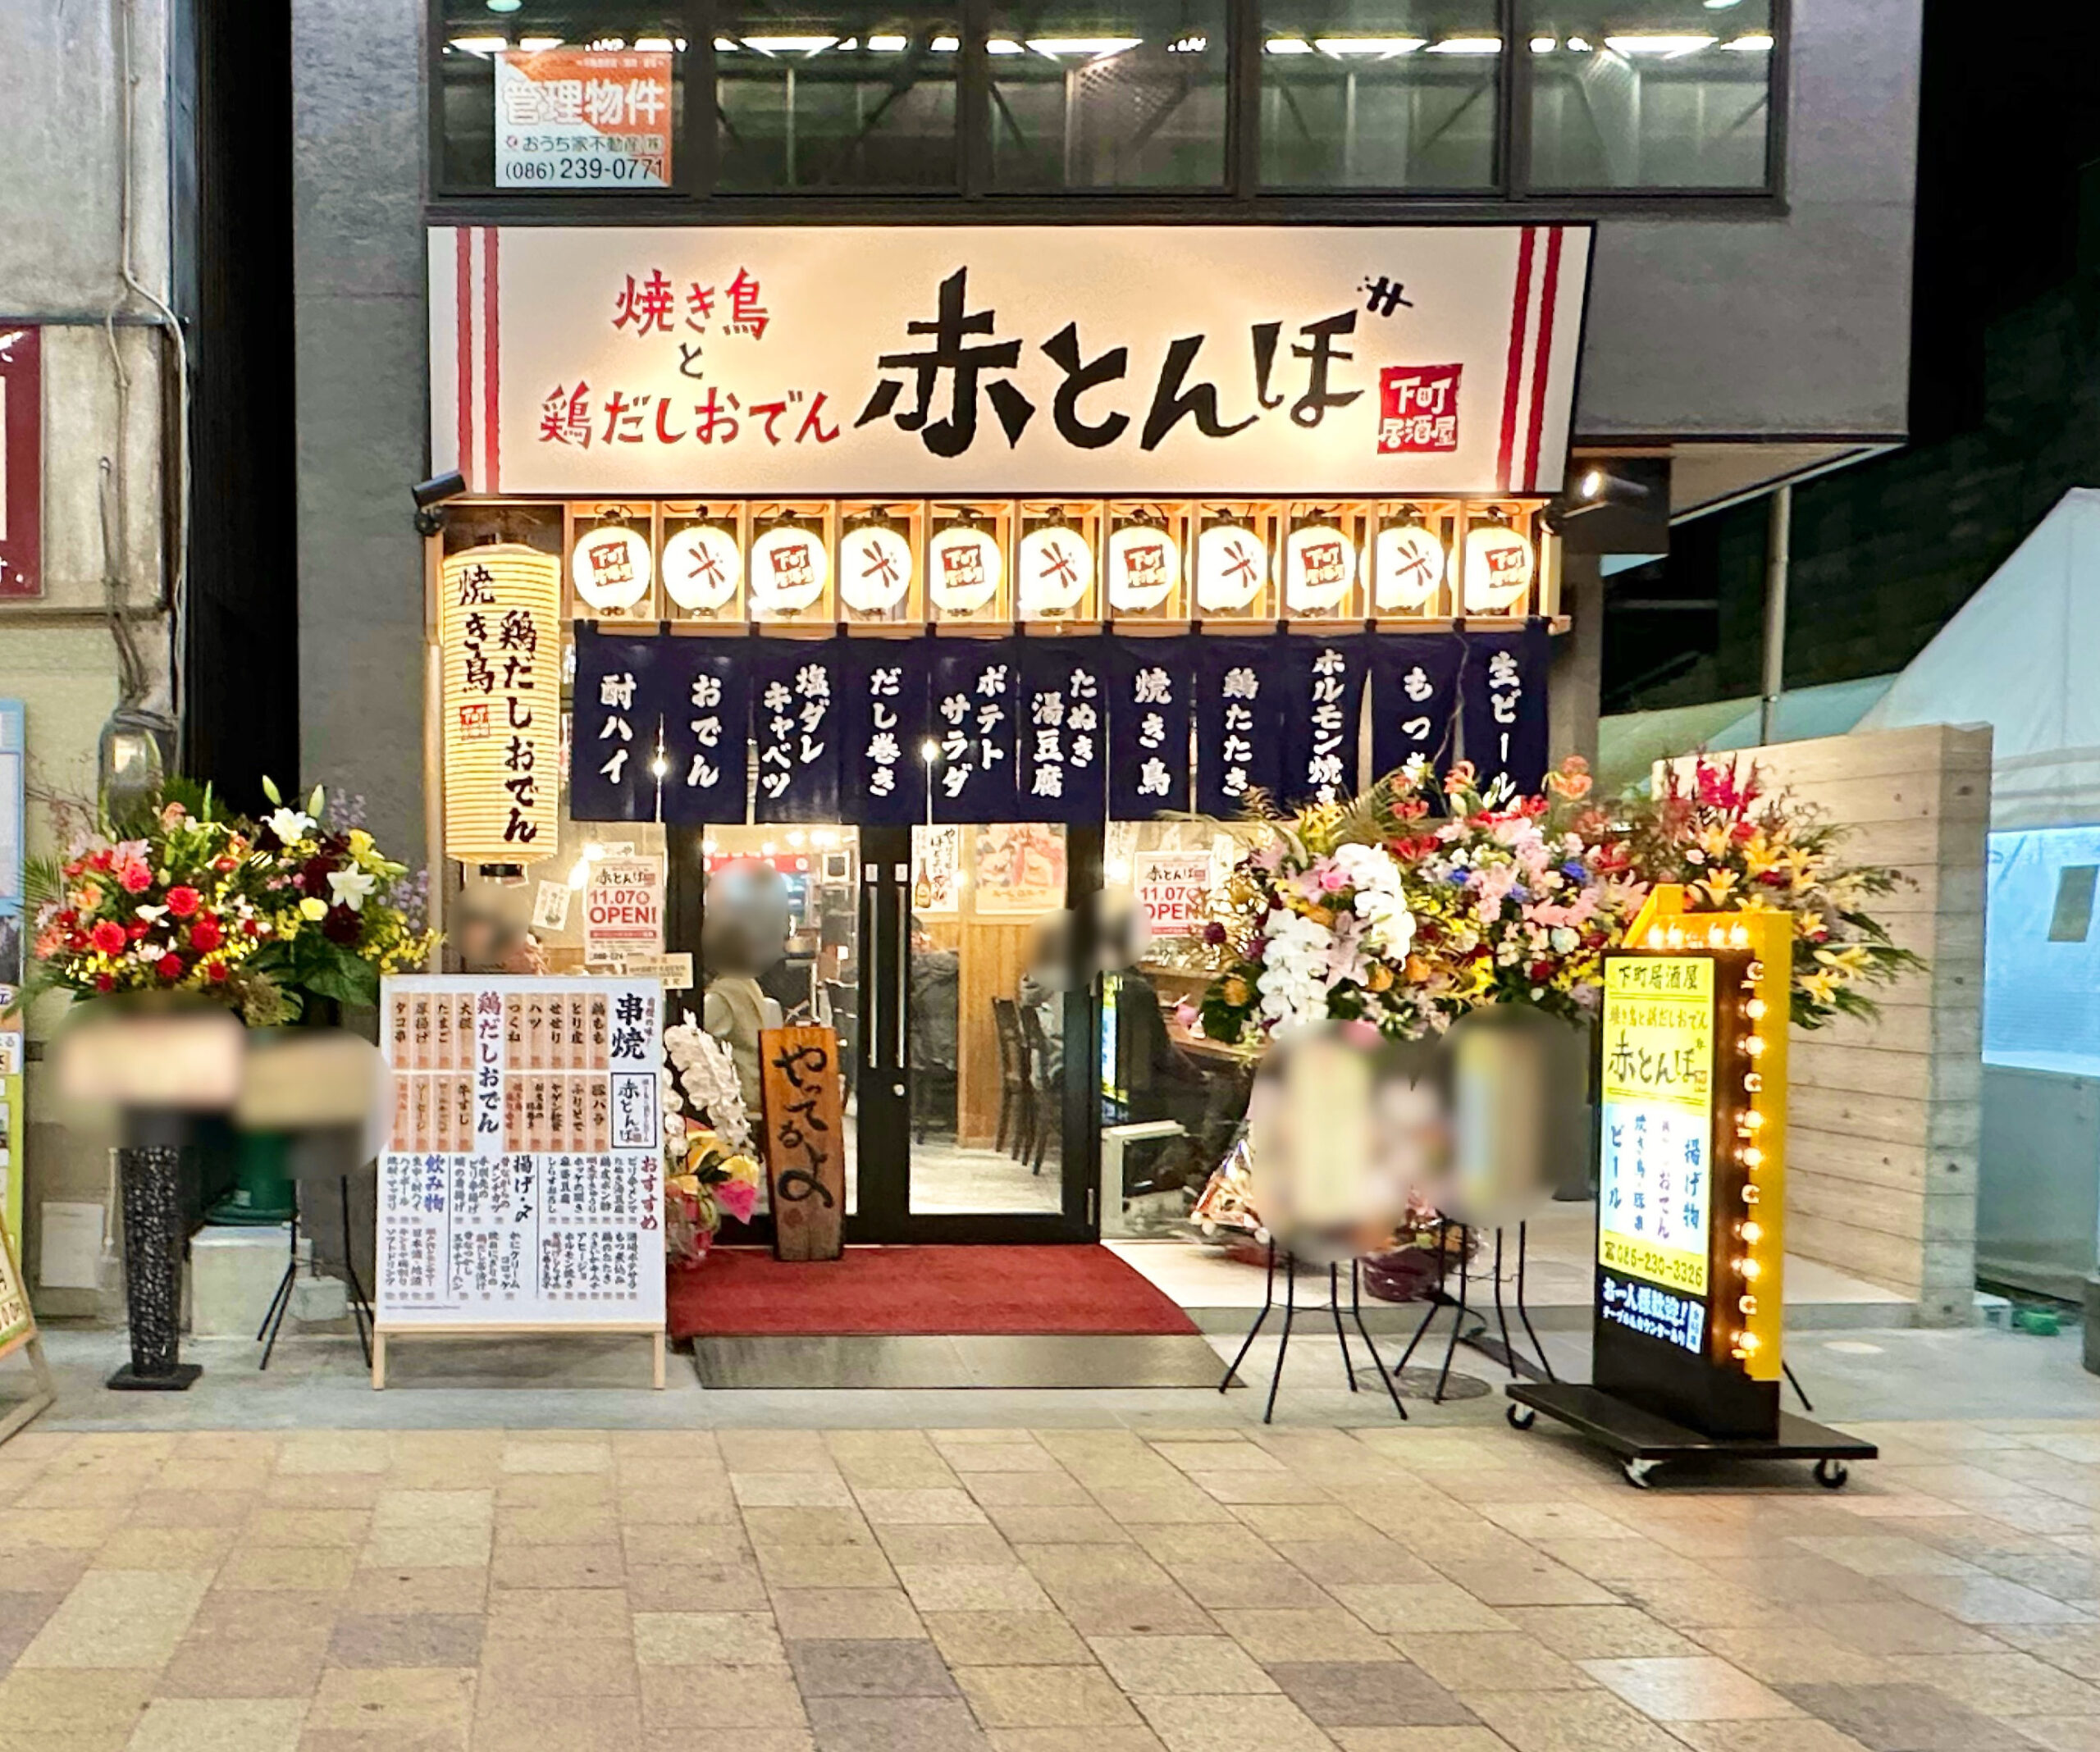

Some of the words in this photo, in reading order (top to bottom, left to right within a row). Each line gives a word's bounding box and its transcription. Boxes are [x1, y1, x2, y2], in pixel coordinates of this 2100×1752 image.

[502, 78, 665, 125] 管理物件
[612, 266, 771, 340] 焼き鳥
[678, 343, 704, 379] と
[854, 264, 1413, 458] 赤とんぼ
[1390, 376, 1453, 414] 下町
[538, 381, 840, 449] 鶏だしおでん
[1378, 414, 1456, 448] 居酒屋
[459, 565, 496, 694] 焼き鳥
[499, 609, 538, 843] 鶏だしおでん
[600, 673, 637, 785] 酎ハイ
[687, 674, 723, 788] おでん
[761, 682, 796, 798] キャベツ
[796, 664, 830, 764] 塩ダレ
[866, 668, 902, 796] だし巻き
[940, 694, 973, 797] サラダ
[976, 664, 1007, 770] ポテト
[1030, 692, 1065, 797] 湯豆腐
[1066, 669, 1097, 768] たぬき
[1134, 667, 1172, 796] 焼き鳥
[589, 907, 657, 924] OPEN!
[1618, 963, 1699, 990] 下町居酒屋
[477, 991, 501, 1134] 鶏だしおでん
[508, 1004, 521, 1043] つくね
[610, 992, 646, 1060] 串焼
[1608, 1029, 1706, 1085] 赤とんぼ
[619, 1078, 641, 1143] 赤とんぼ
[424, 1154, 445, 1213] 飲み物
[640, 1156, 658, 1230] おすすめ
[1609, 1124, 1625, 1210] ビール
[1682, 1138, 1703, 1230] 揚げ物
